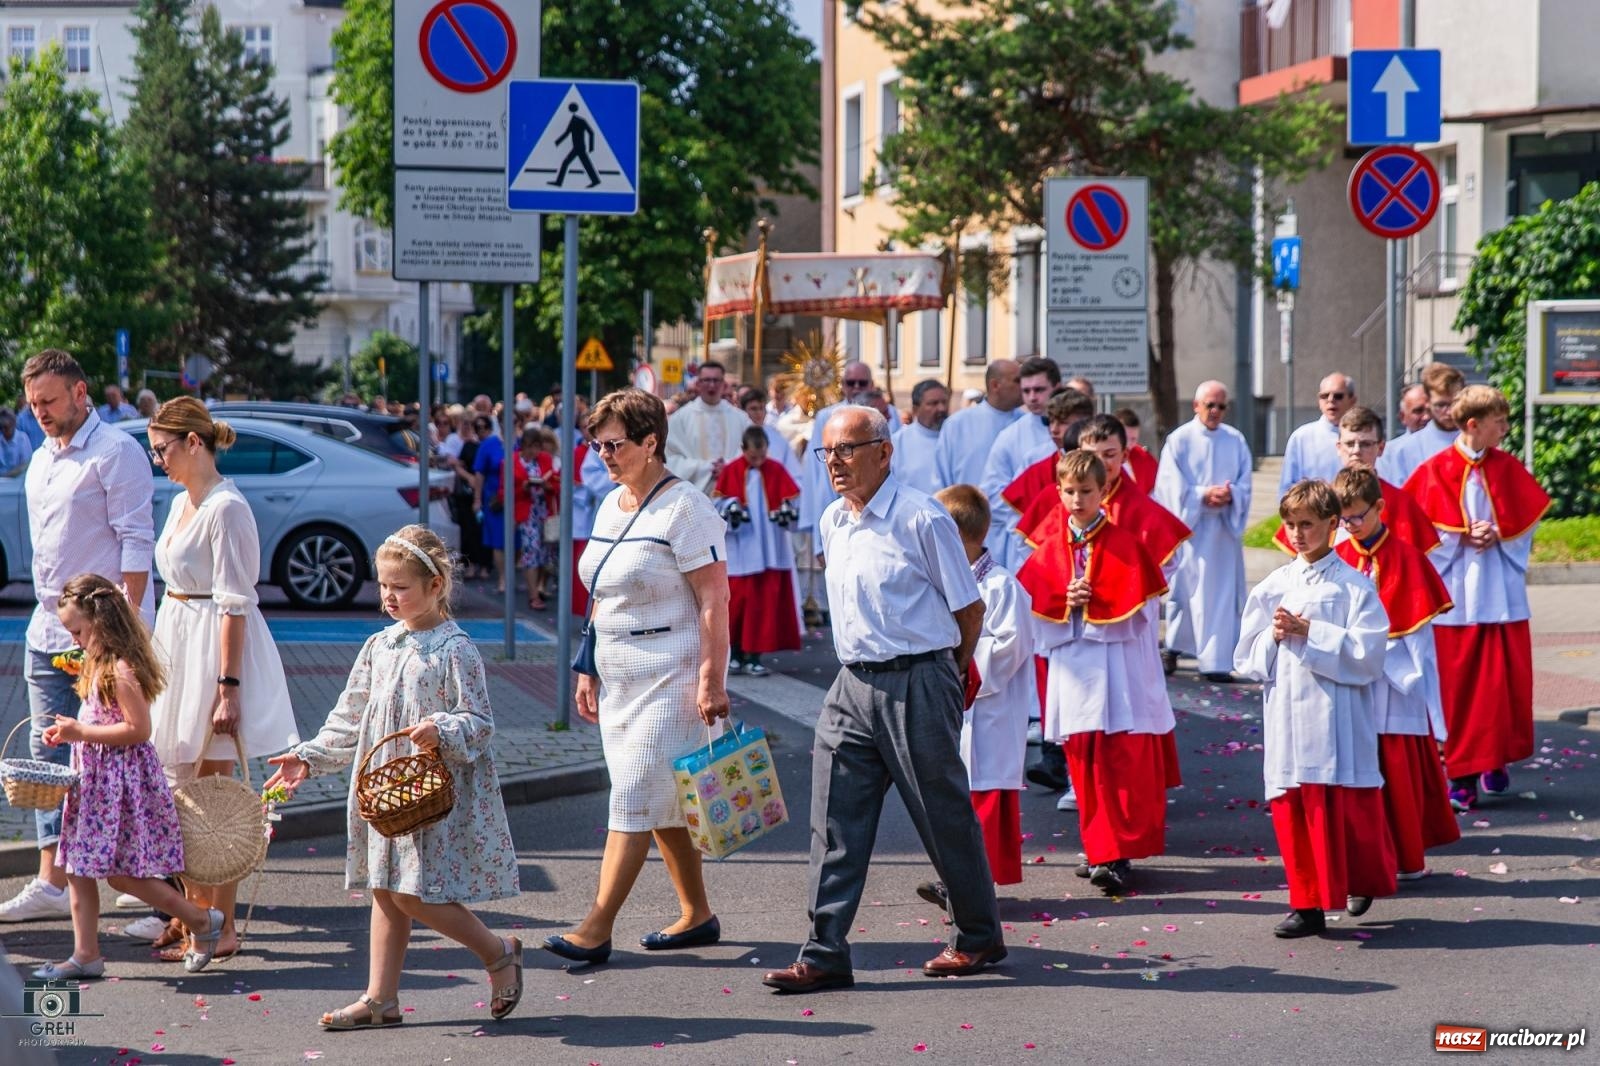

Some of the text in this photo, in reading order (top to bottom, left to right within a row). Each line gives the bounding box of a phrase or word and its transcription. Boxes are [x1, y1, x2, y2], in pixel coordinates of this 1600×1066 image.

[435, 118, 491, 128] ograniczony
[403, 127, 415, 136] do
[418, 127, 423, 136] 1
[442, 140, 464, 149] 9.00
[475, 140, 499, 150] 17.00
